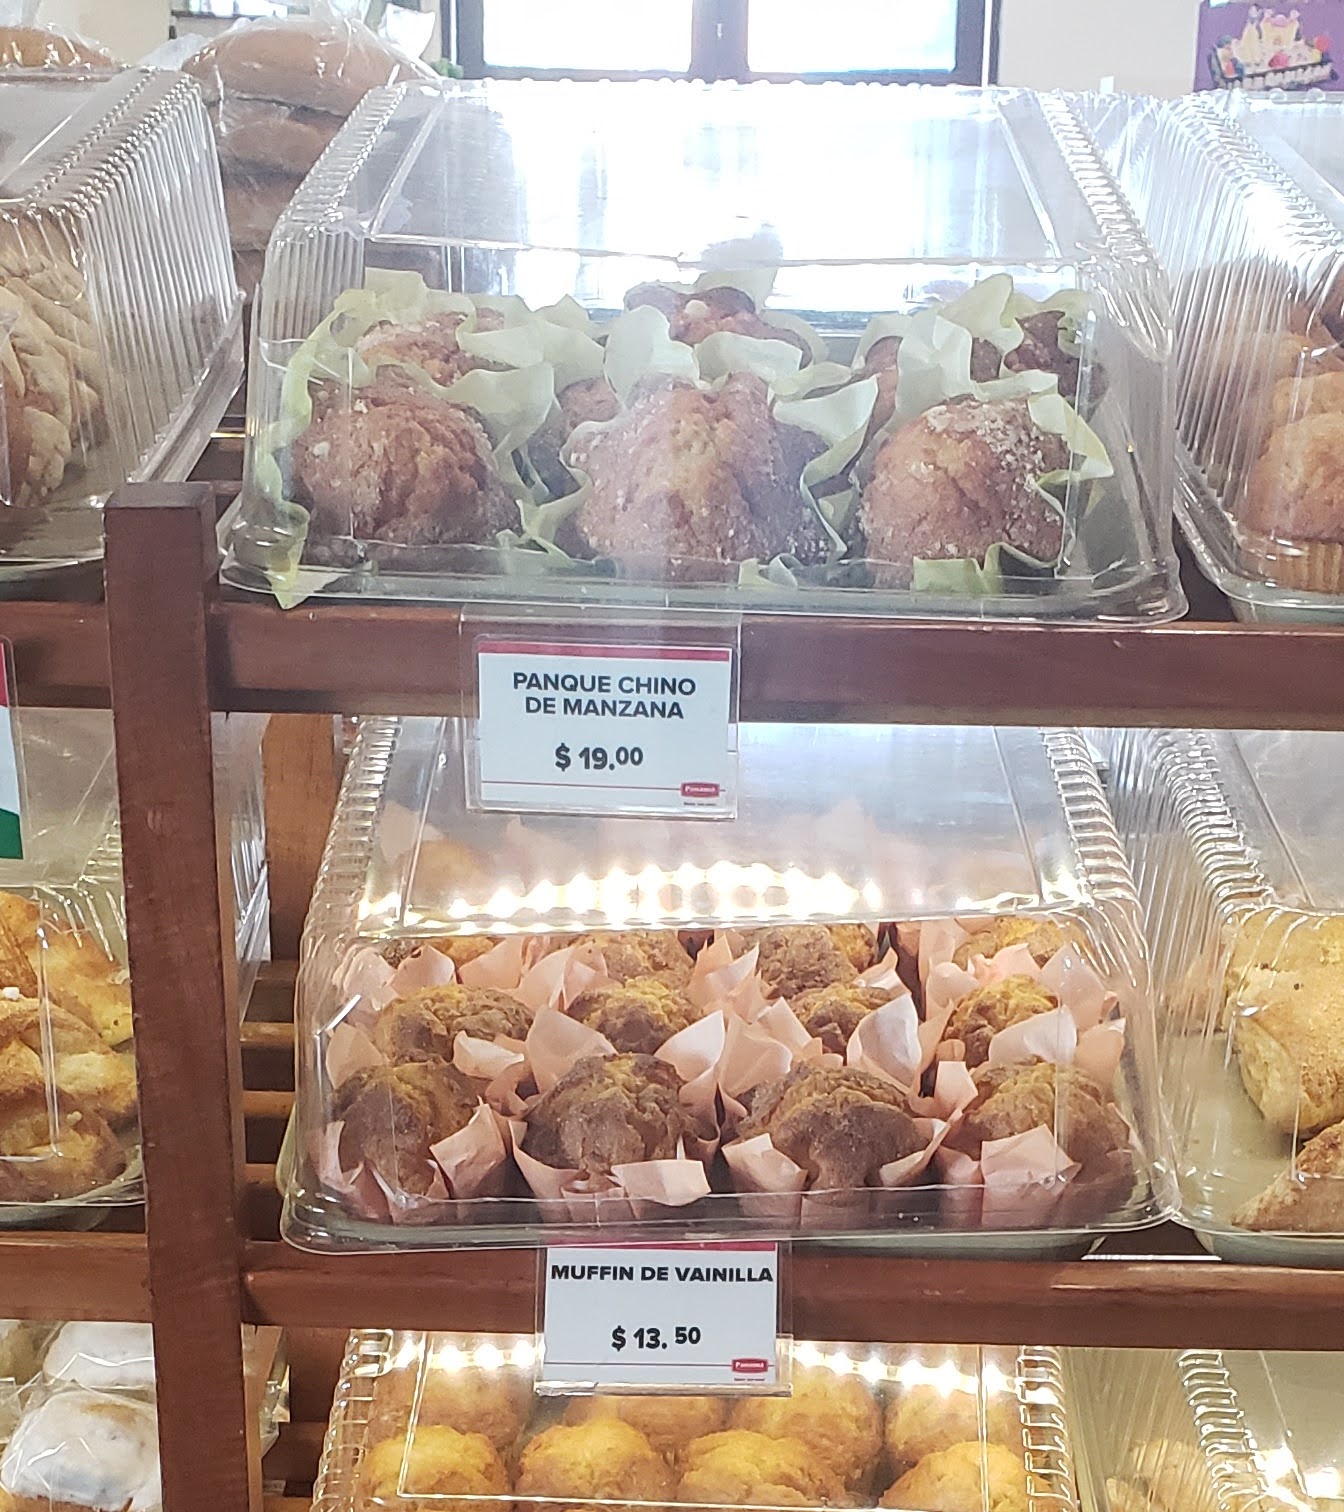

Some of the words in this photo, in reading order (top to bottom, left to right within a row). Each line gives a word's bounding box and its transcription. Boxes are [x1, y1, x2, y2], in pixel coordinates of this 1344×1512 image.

[513, 672, 611, 693] PANQUE
[618, 676, 696, 696] CHINO
[525, 696, 556, 715] DE
[563, 698, 684, 719] MANZANA
[555, 742, 571, 772] $
[578, 746, 644, 770] 19.00
[551, 1264, 634, 1281] MUFFIN
[640, 1266, 669, 1281] DE
[674, 1267, 774, 1282] VAINILLA
[611, 1325, 627, 1352] $
